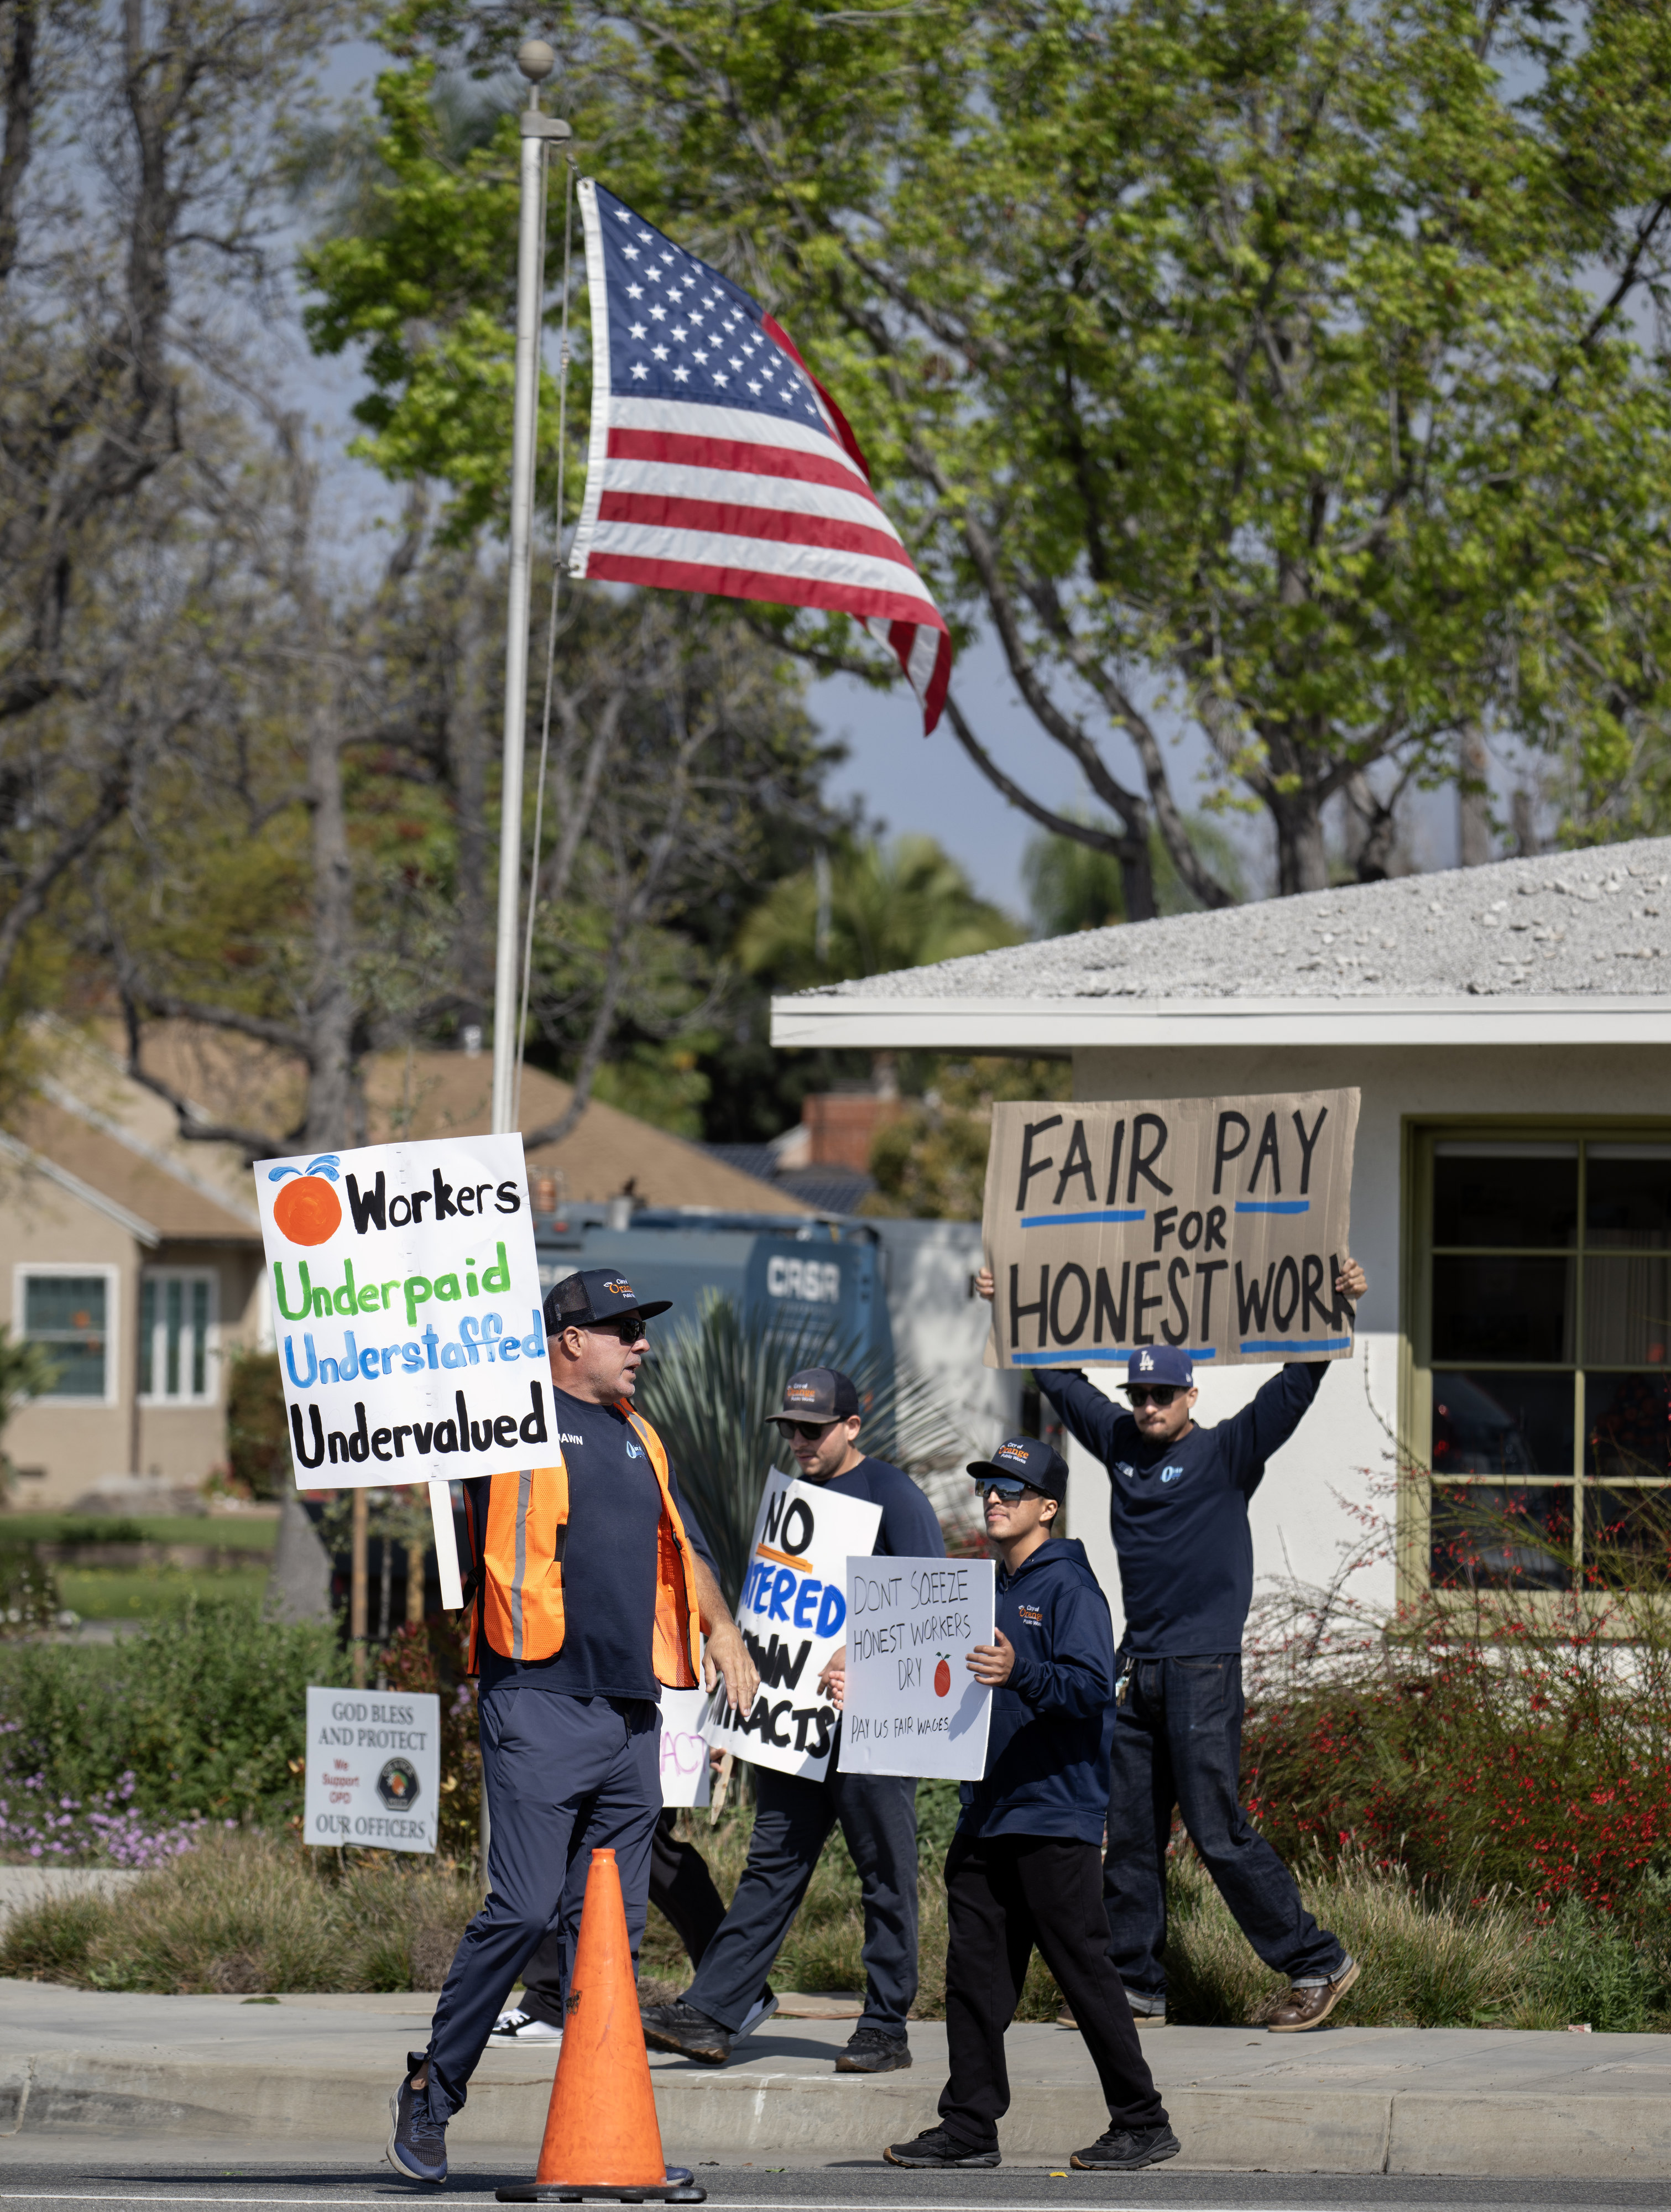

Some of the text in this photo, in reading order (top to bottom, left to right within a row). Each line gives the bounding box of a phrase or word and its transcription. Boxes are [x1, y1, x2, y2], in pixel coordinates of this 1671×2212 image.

[1016, 1107, 1328, 1211] FAIR PAY
[345, 1167, 520, 1234] Workers
[1153, 1205, 1228, 1252] FOR
[273, 1241, 511, 1327] Underpaid
[1010, 1253, 1355, 1347] HONEST WORK
[284, 1309, 545, 1389] Understaffed
[1140, 1350, 1154, 1371] LA
[787, 1387, 816, 1397] Orange
[290, 1380, 548, 1469] Undervalued
[999, 1446, 1029, 1458] Orange
[1013, 1455, 1026, 1464] Works
[761, 1491, 814, 1555] NO
[911, 1570, 968, 1609] SQEEZE
[854, 1613, 970, 1662] HONEST WORKERS
[899, 1658, 922, 1691] DRY
[332, 1701, 414, 1725] GOD BLESS
[852, 1715, 948, 1743] PAY US FAIR WAGES
[318, 1726, 427, 1751] AND PROTECT
[322, 1773, 359, 1788] Support
[333, 1759, 349, 1770] We
[316, 1814, 425, 1839] OUR OFFICERS
